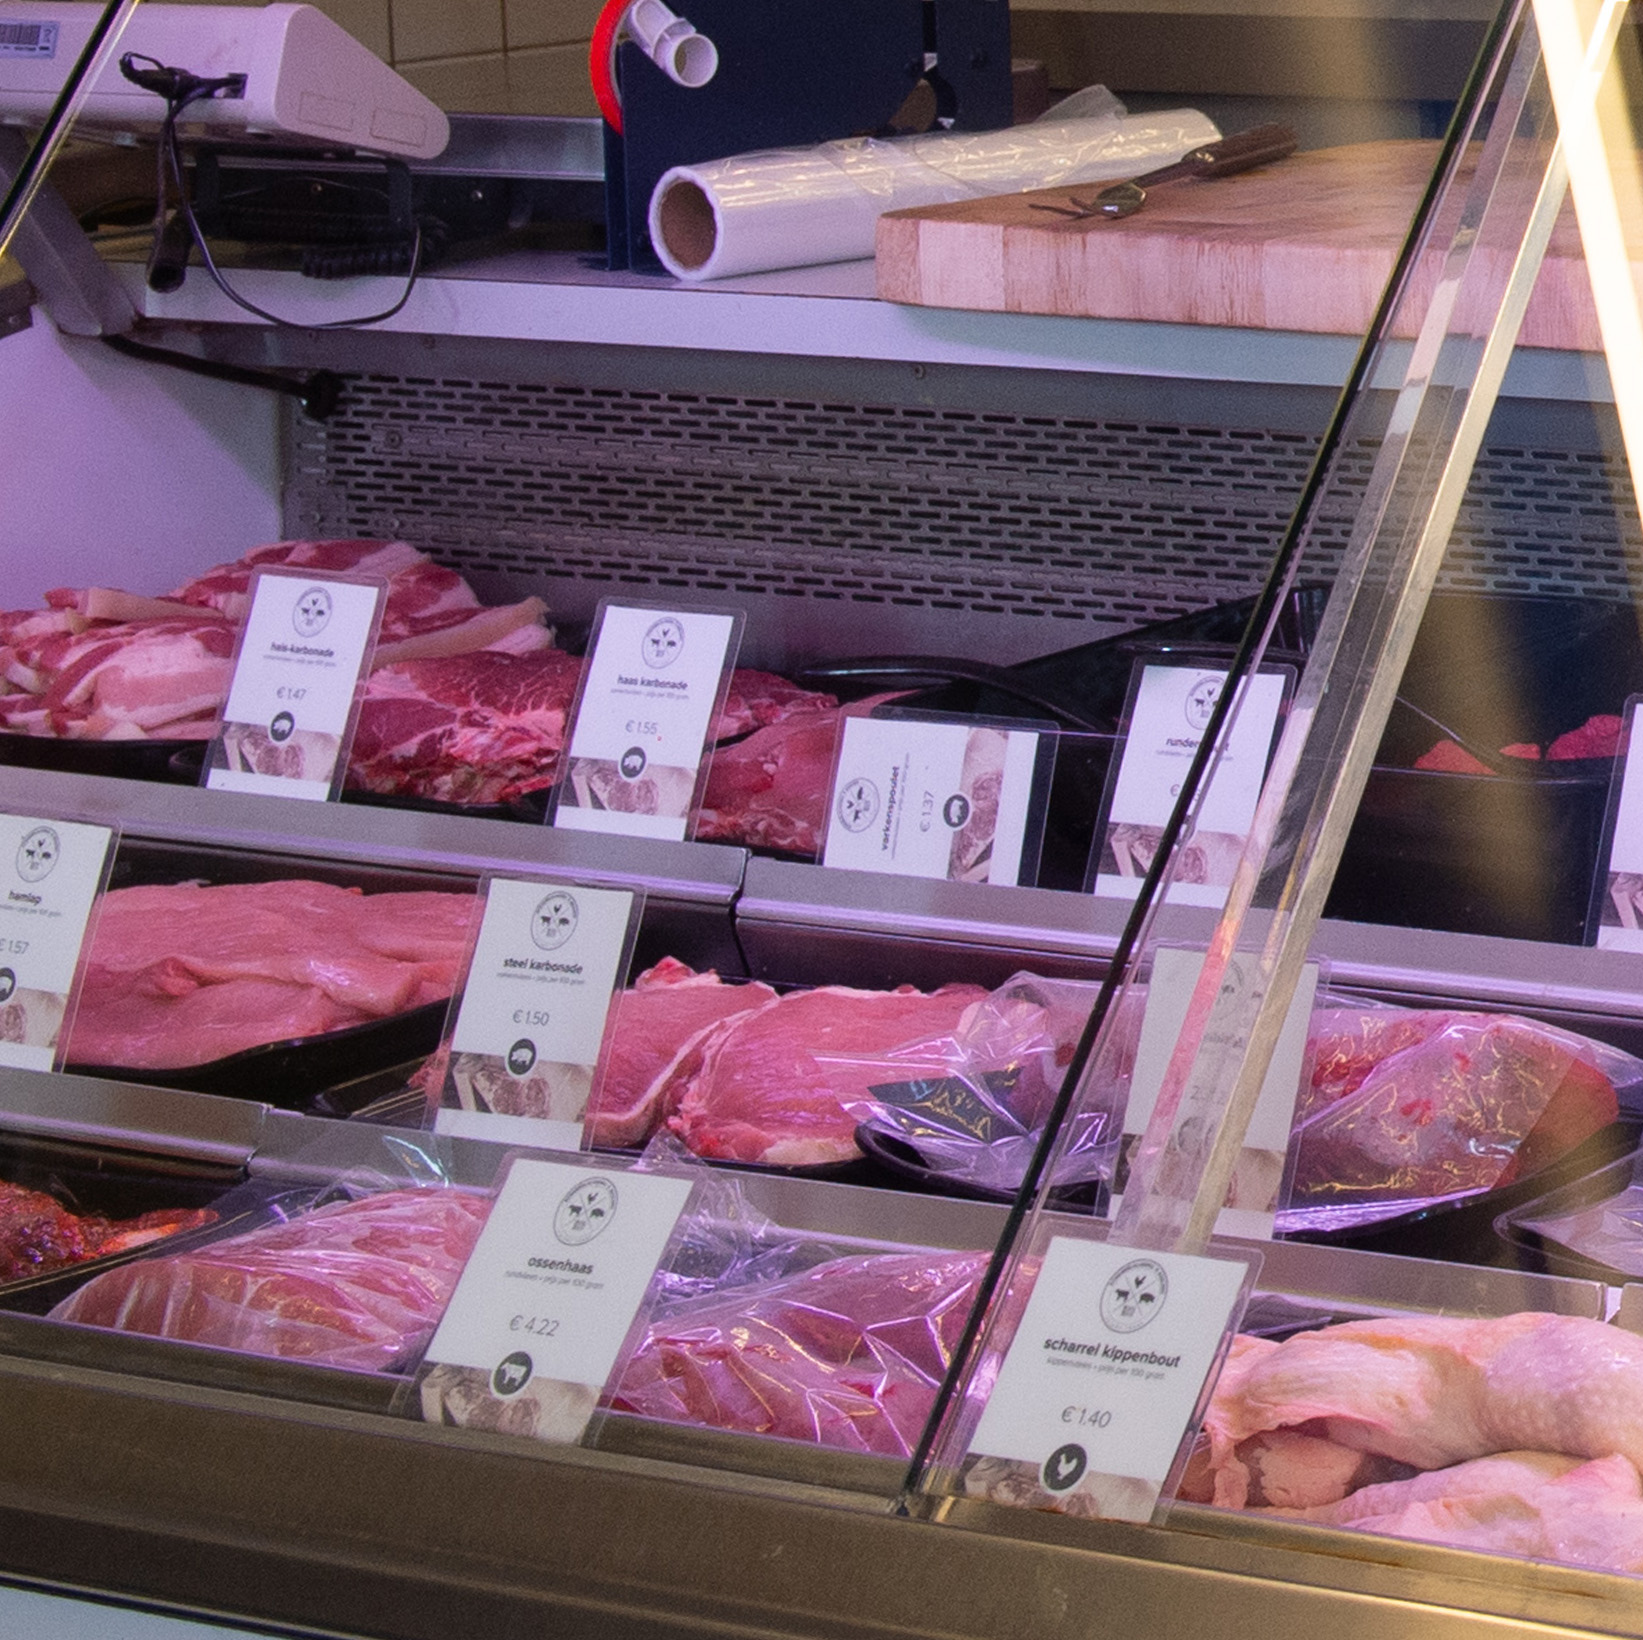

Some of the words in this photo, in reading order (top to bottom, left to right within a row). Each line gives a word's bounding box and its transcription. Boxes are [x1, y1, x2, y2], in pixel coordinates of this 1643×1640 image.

[277, 686, 285, 699] €
[626, 720, 635, 733] €
[504, 958, 528, 968] steel
[529, 959, 583, 974] karbonade
[513, 1010, 523, 1023] €
[525, 1010, 550, 1026] 1.50
[528, 1256, 593, 1275] ossenhaas
[509, 1314, 523, 1331] €
[525, 1316, 559, 1337] 4.22
[1044, 1338, 1101, 1356] scharrel
[1102, 1345, 1181, 1368] kippenbout
[1062, 1406, 1076, 1423] €
[1079, 1408, 1112, 1428] 1.40
